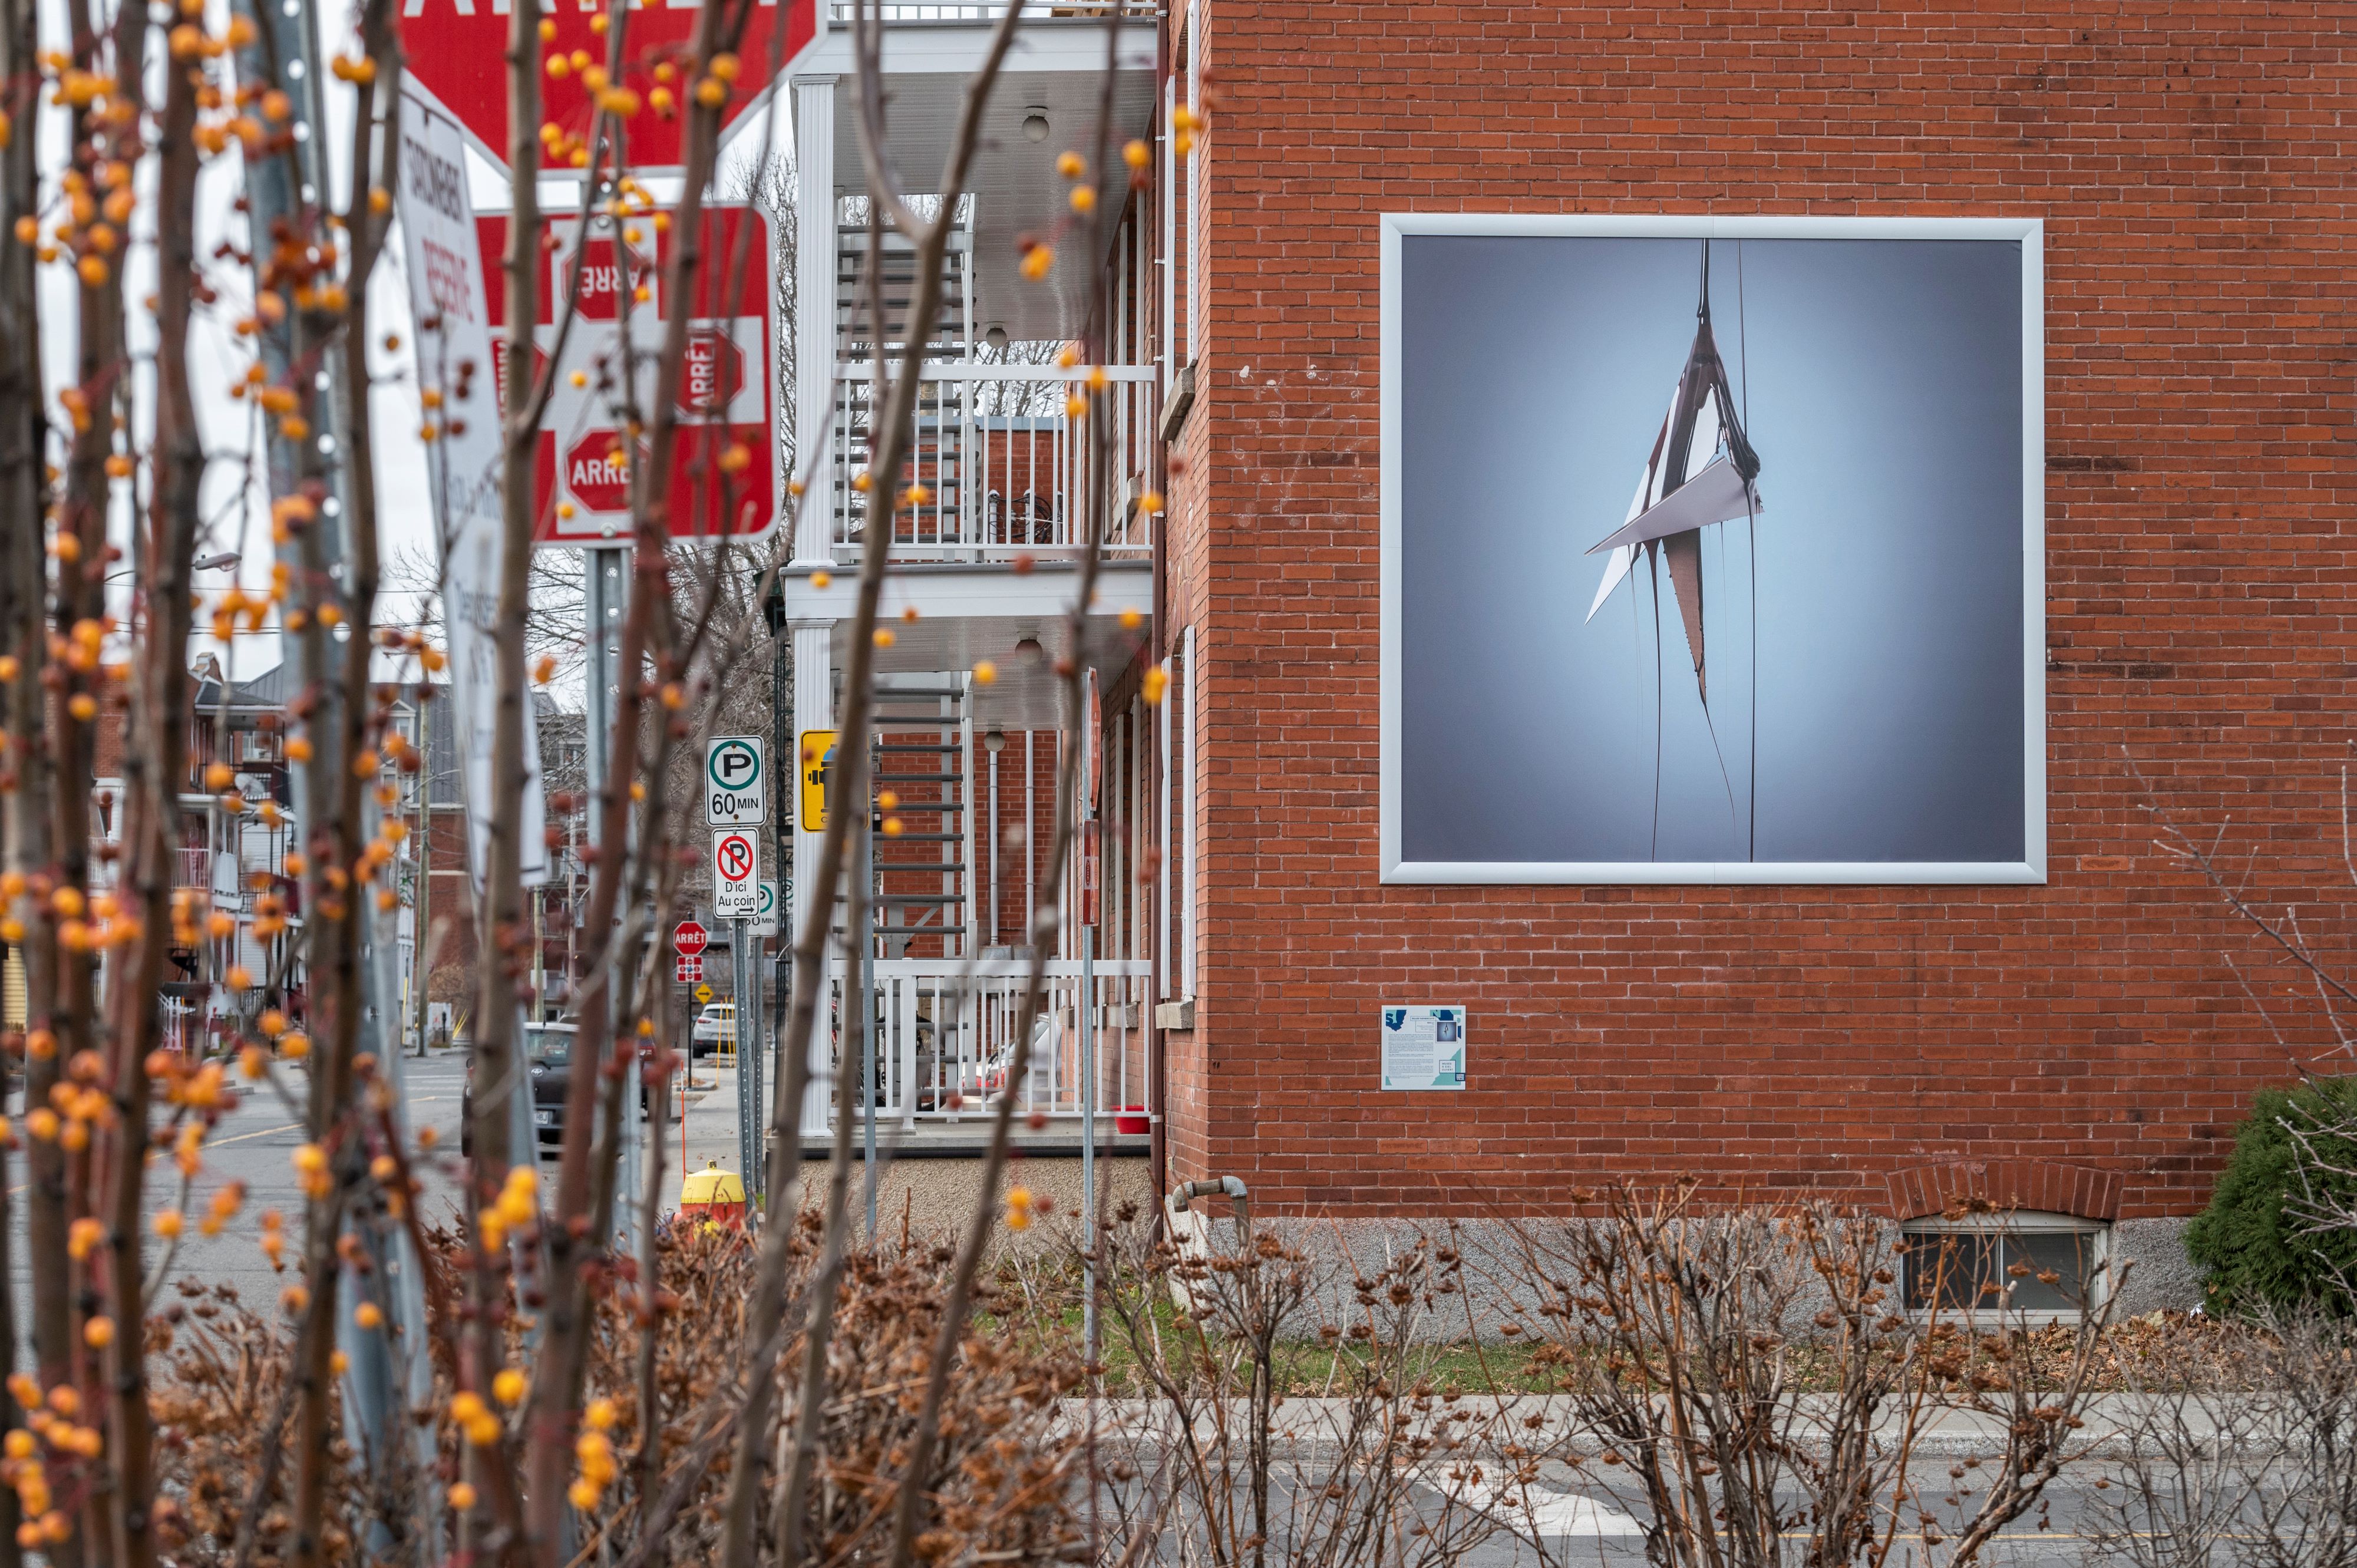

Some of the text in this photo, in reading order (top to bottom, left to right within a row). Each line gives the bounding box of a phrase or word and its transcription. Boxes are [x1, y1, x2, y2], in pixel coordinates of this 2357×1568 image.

[577, 266, 641, 298] ARRÊ
[572, 457, 646, 486] ARR
[723, 754, 752, 777] P
[712, 793, 759, 815] 60 MIN
[725, 882, 747, 892] D'ici
[718, 896, 731, 906] Au
[734, 895, 755, 906] coin
[675, 931, 705, 944] ARRÊT
